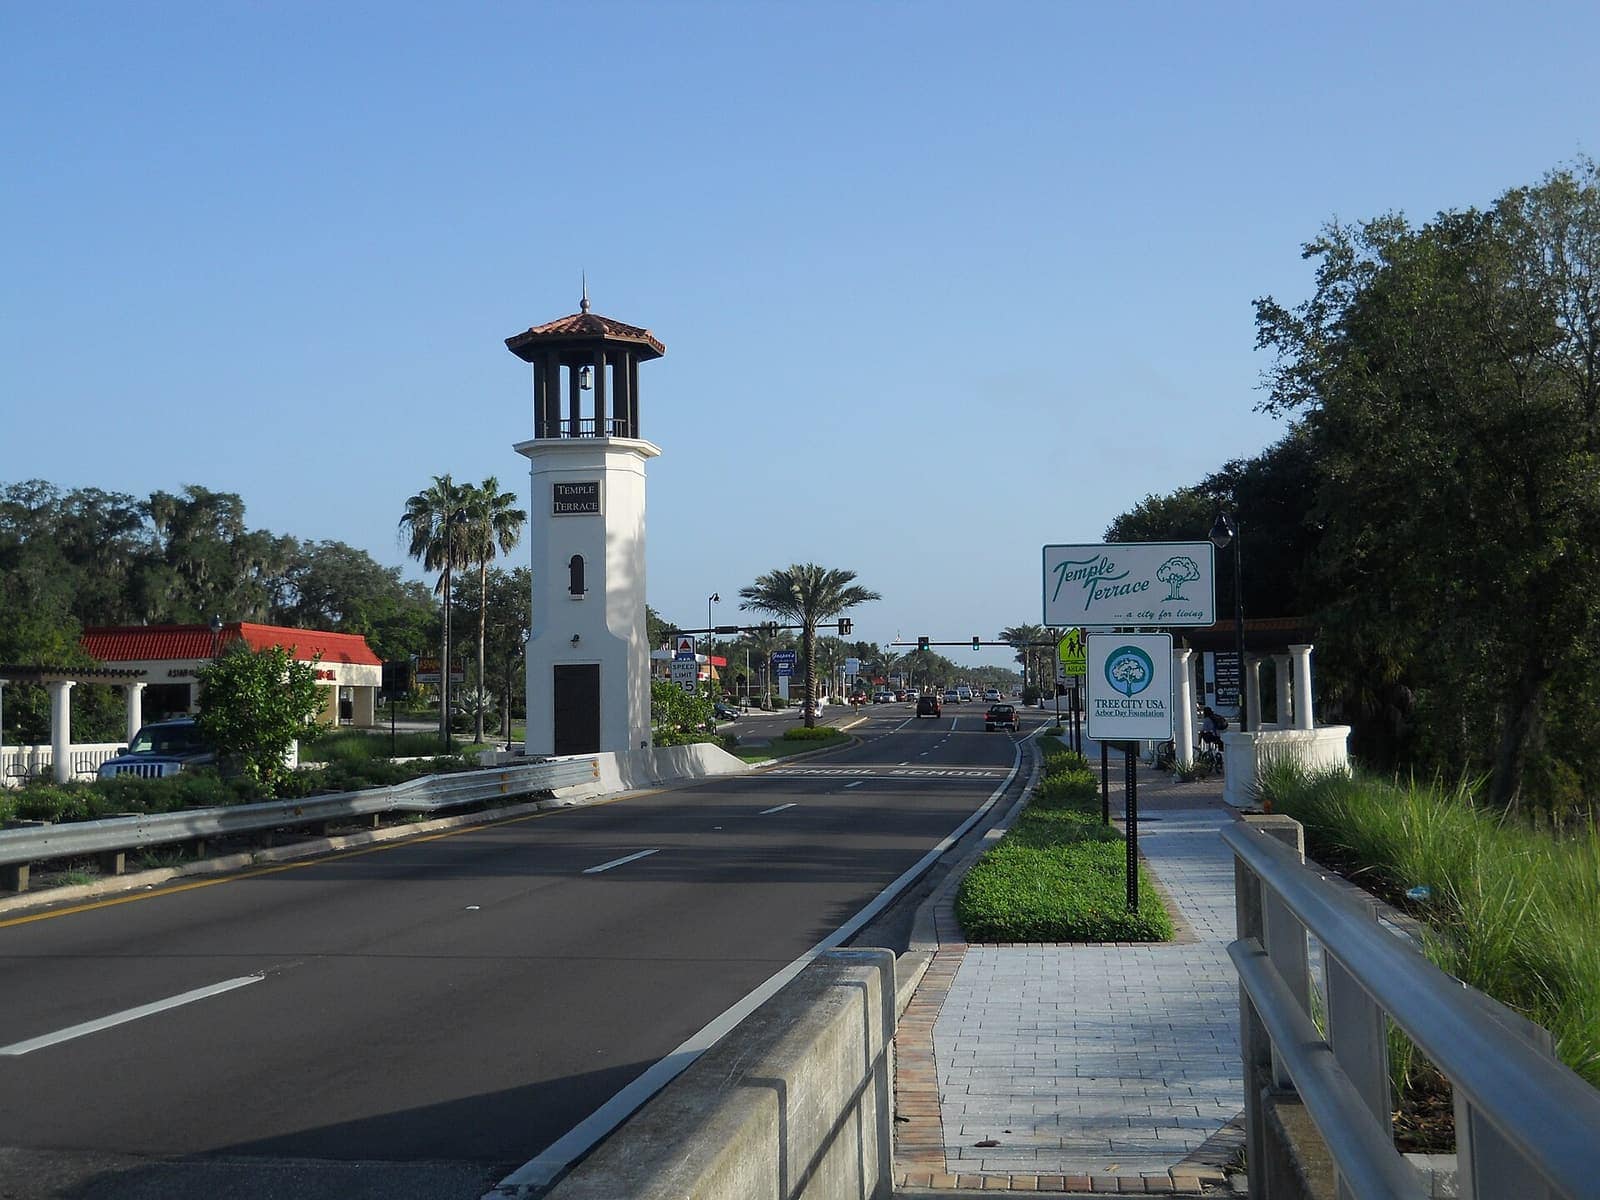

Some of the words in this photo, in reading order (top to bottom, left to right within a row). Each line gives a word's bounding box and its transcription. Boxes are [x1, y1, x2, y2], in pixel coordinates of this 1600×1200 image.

[557, 485, 595, 495] TEMPLE
[555, 501, 598, 511] TERRACE
[1053, 554, 1115, 602] Temple
[1083, 570, 1150, 611] Terrace
[1136, 609, 1155, 619] city
[1158, 609, 1172, 620] for
[1176, 609, 1204, 620] living
[1067, 664, 1087, 672] AHEAD
[1095, 699, 1120, 709] TREE
[1121, 699, 1144, 709] CITY
[1095, 710, 1114, 718] Arbor
[1115, 709, 1127, 718] Day
[1128, 709, 1165, 718] Foundation
